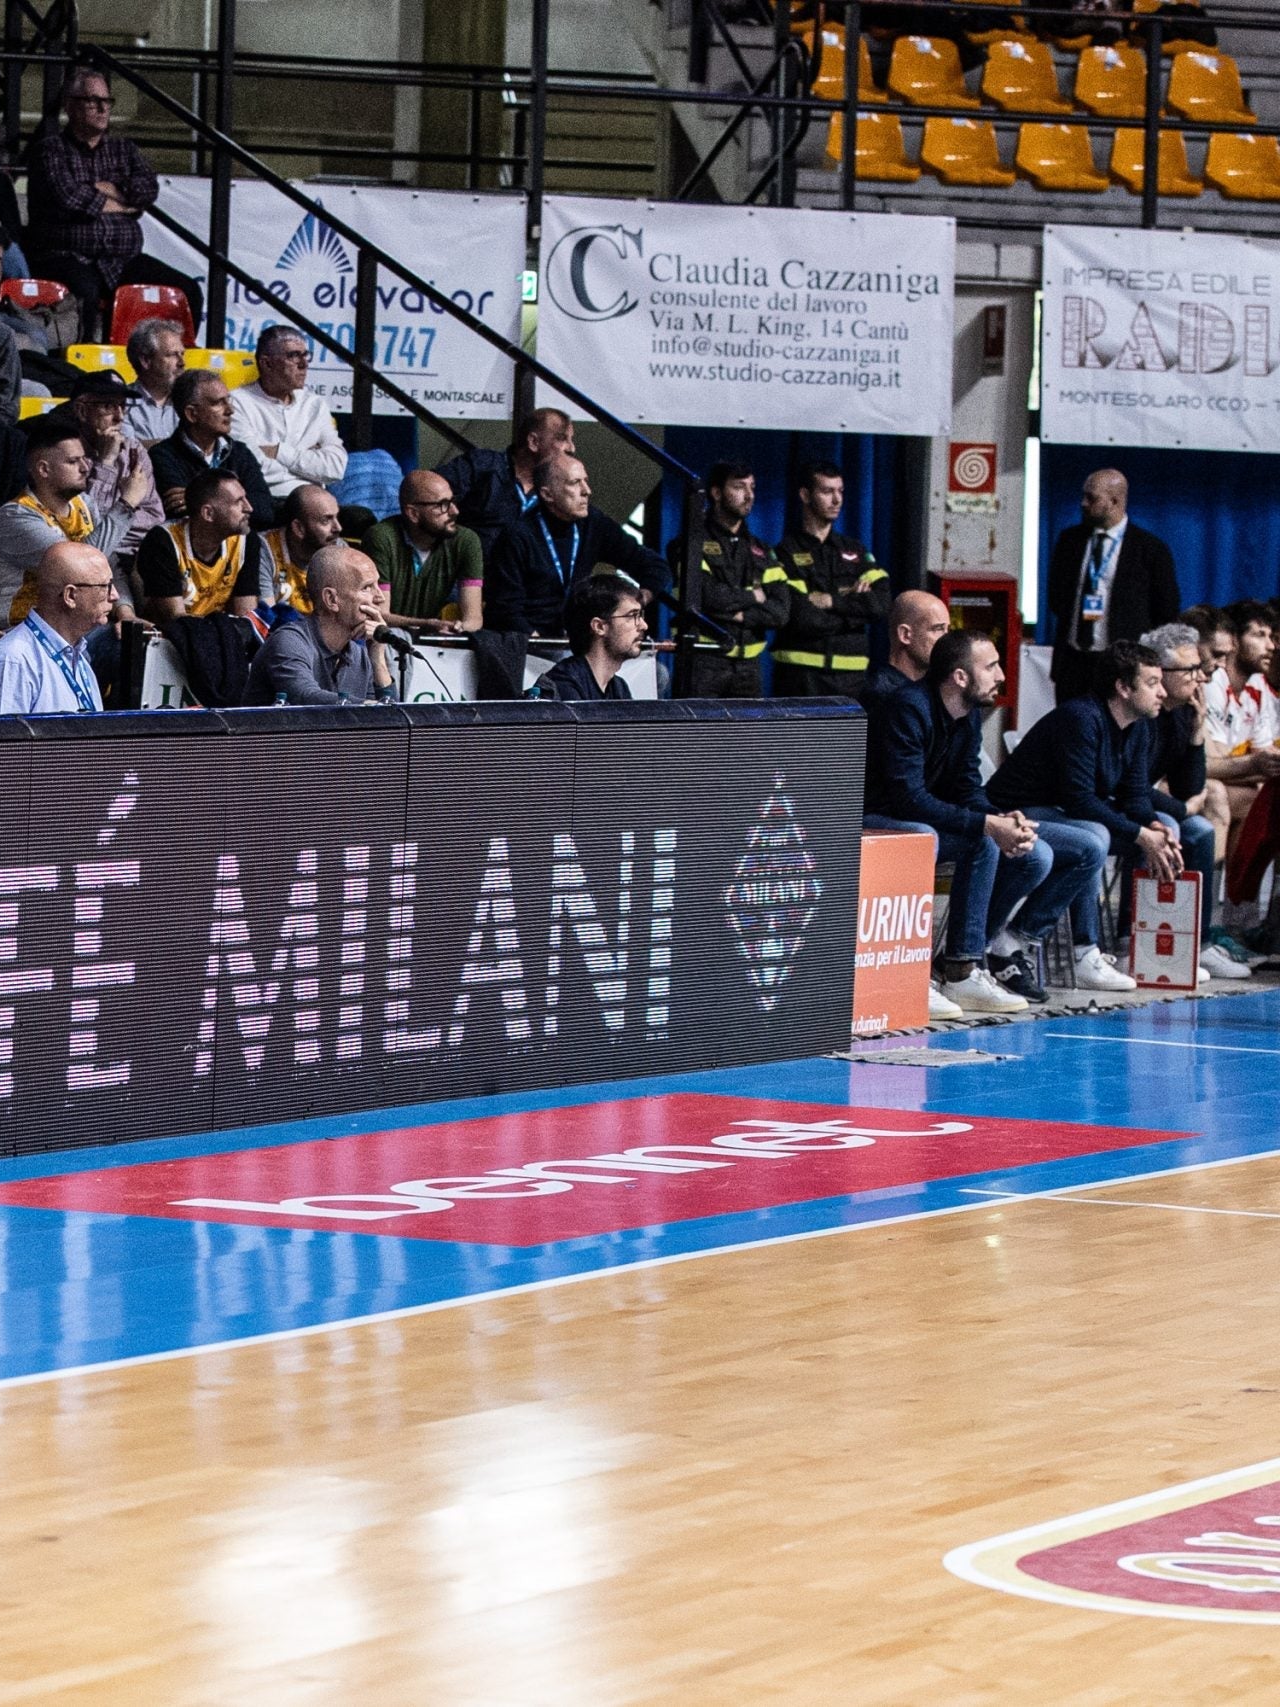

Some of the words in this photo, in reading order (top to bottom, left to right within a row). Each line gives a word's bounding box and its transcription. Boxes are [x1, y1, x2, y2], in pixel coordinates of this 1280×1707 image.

[649, 253, 769, 288] Claudia
[780, 259, 940, 303] Cazzaniga
[1063, 267, 1183, 291] IMPRESA
[1192, 273, 1271, 296] EDILE
[649, 289, 760, 310] consulente
[767, 292, 798, 312] del
[805, 294, 868, 315] lavoro
[649, 310, 684, 331] Via
[692, 312, 719, 333] M.
[728, 314, 748, 334] L.
[821, 318, 844, 339] 14
[850, 319, 909, 341] Cantù
[651, 334, 900, 368] info@studio-cazzaniga.it
[648, 362, 902, 392] www.studio-cazzaniga.it
[424, 389, 507, 404] MONTASCALE
[1060, 390, 1202, 410] MONTESOLARO
[1207, 395, 1251, 412] (CO)
[858, 893, 934, 944] URING
[191, 829, 678, 1080] MILANI
[876, 950, 894, 971] per
[900, 945, 933, 964] Lavoro
[172, 1118, 975, 1222] bennet
